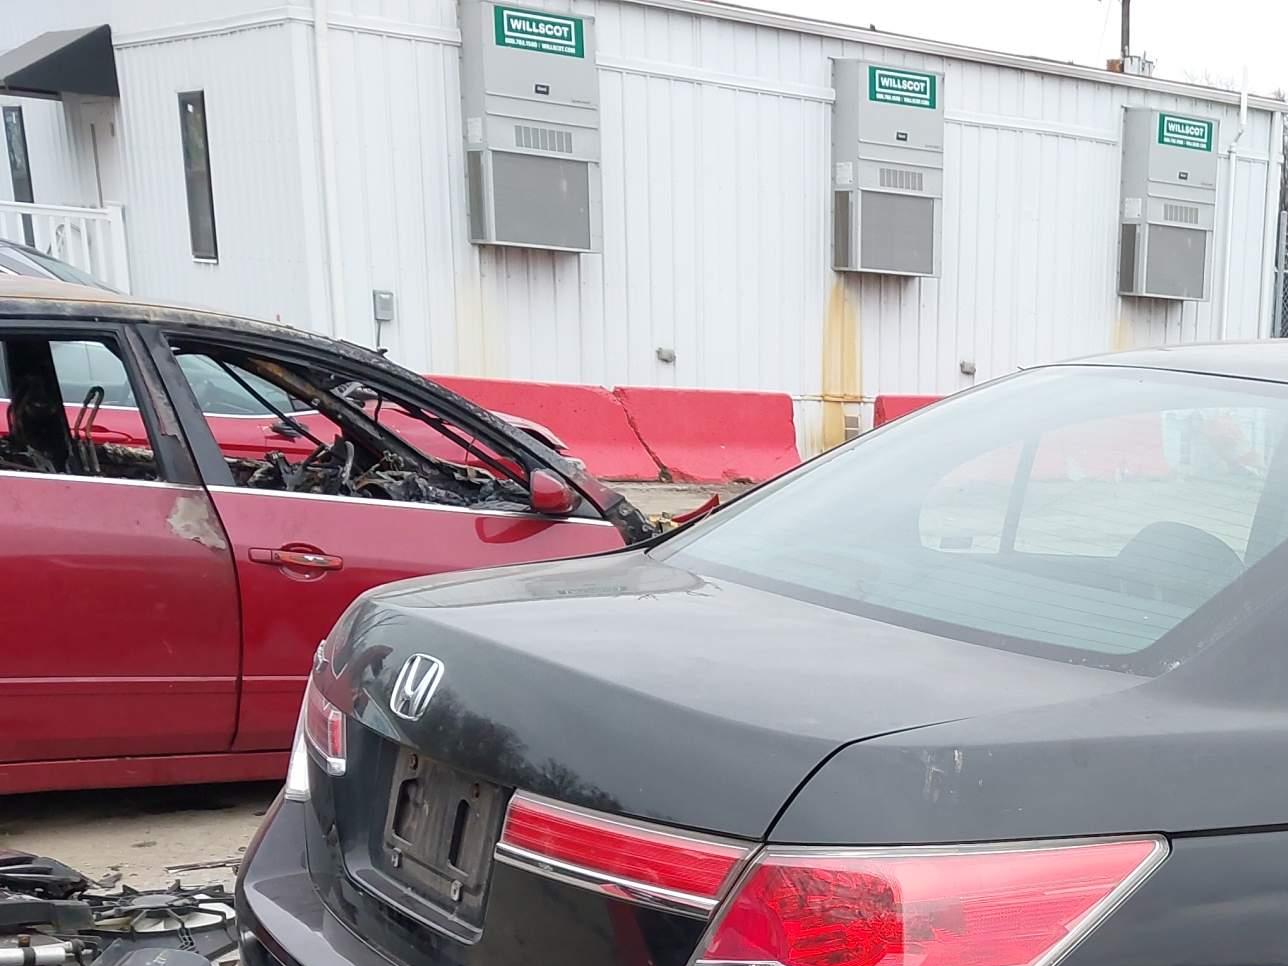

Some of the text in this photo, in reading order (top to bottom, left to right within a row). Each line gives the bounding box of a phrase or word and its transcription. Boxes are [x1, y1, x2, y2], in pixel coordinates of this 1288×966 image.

[509, 18, 569, 38] WILLSCOT
[880, 76, 926, 93] WILLSCOT
[1168, 122, 1204, 137] WILLSCOT
